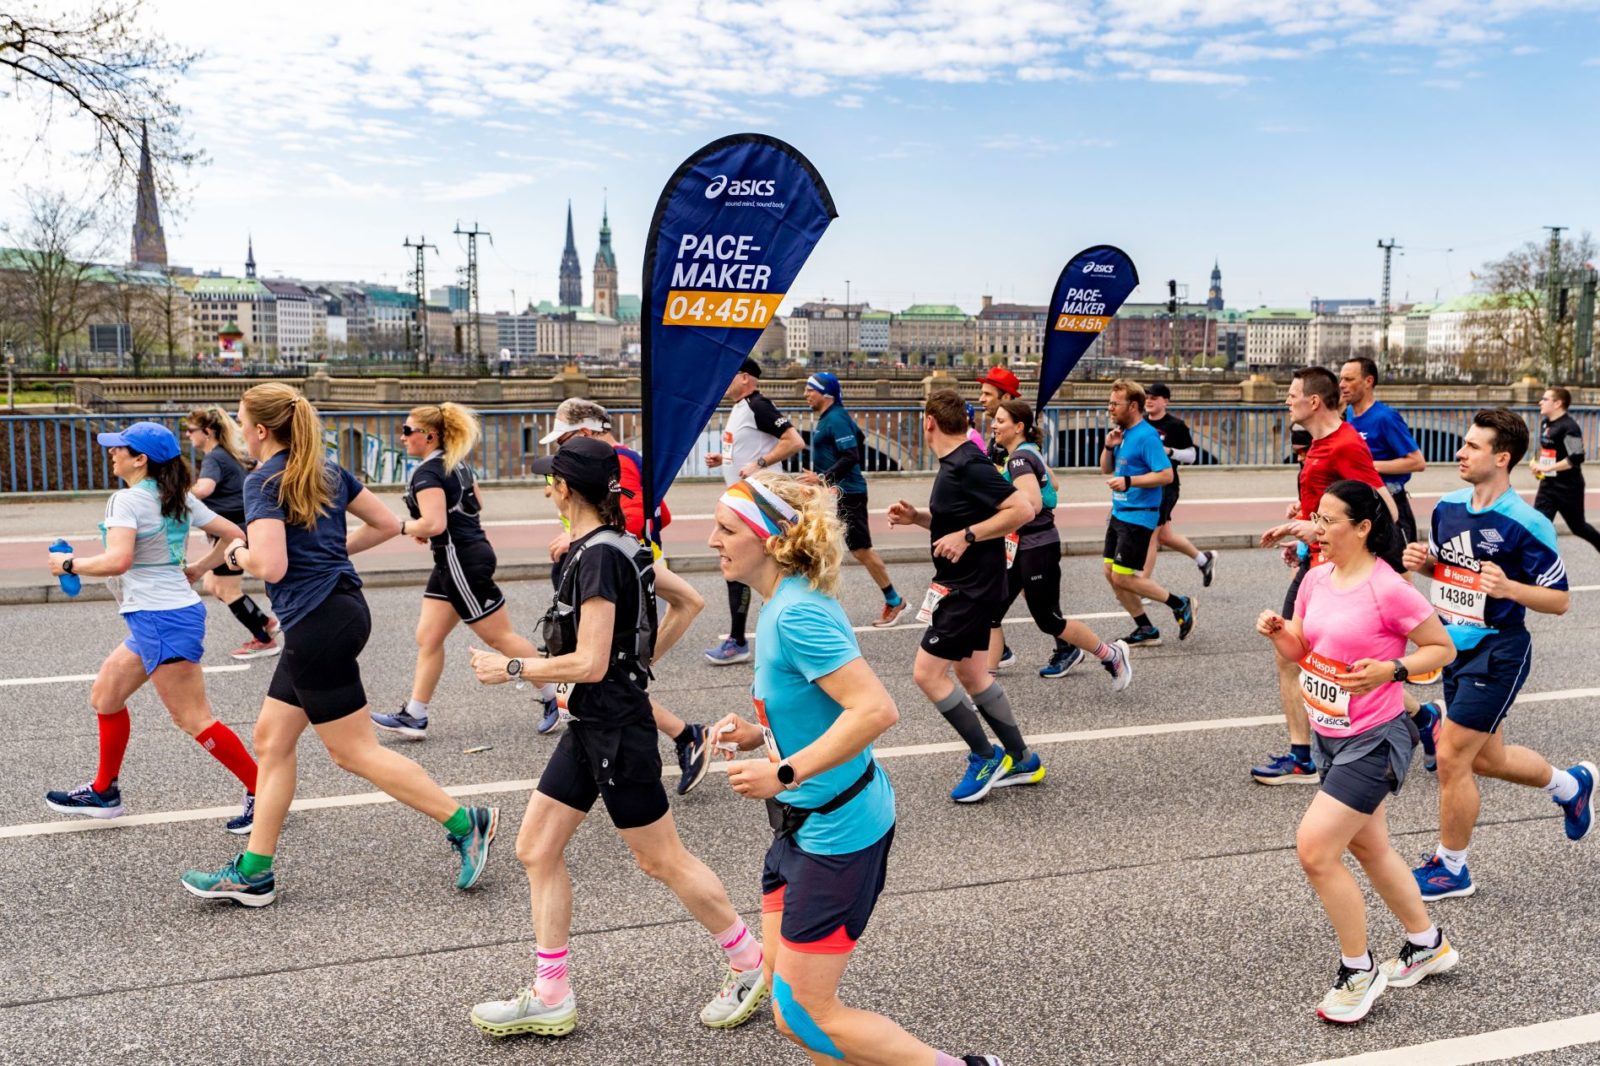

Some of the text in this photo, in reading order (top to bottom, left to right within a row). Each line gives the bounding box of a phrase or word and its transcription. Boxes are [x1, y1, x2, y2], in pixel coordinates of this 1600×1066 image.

[728, 180, 775, 196] asics
[677, 234, 761, 261] PACE-
[670, 262, 772, 290] MAKER
[1093, 264, 1114, 273] asics
[1066, 287, 1102, 301] PACE-
[669, 296, 767, 323] 04:45h
[1061, 301, 1106, 315] MAKER
[1058, 316, 1102, 330] 04:45h
[1440, 549, 1480, 572] adidas
[1451, 570, 1475, 584] Haspa
[1440, 585, 1482, 607] 14388 M
[1312, 656, 1337, 675] Haspa
[1324, 717, 1344, 726] asics
